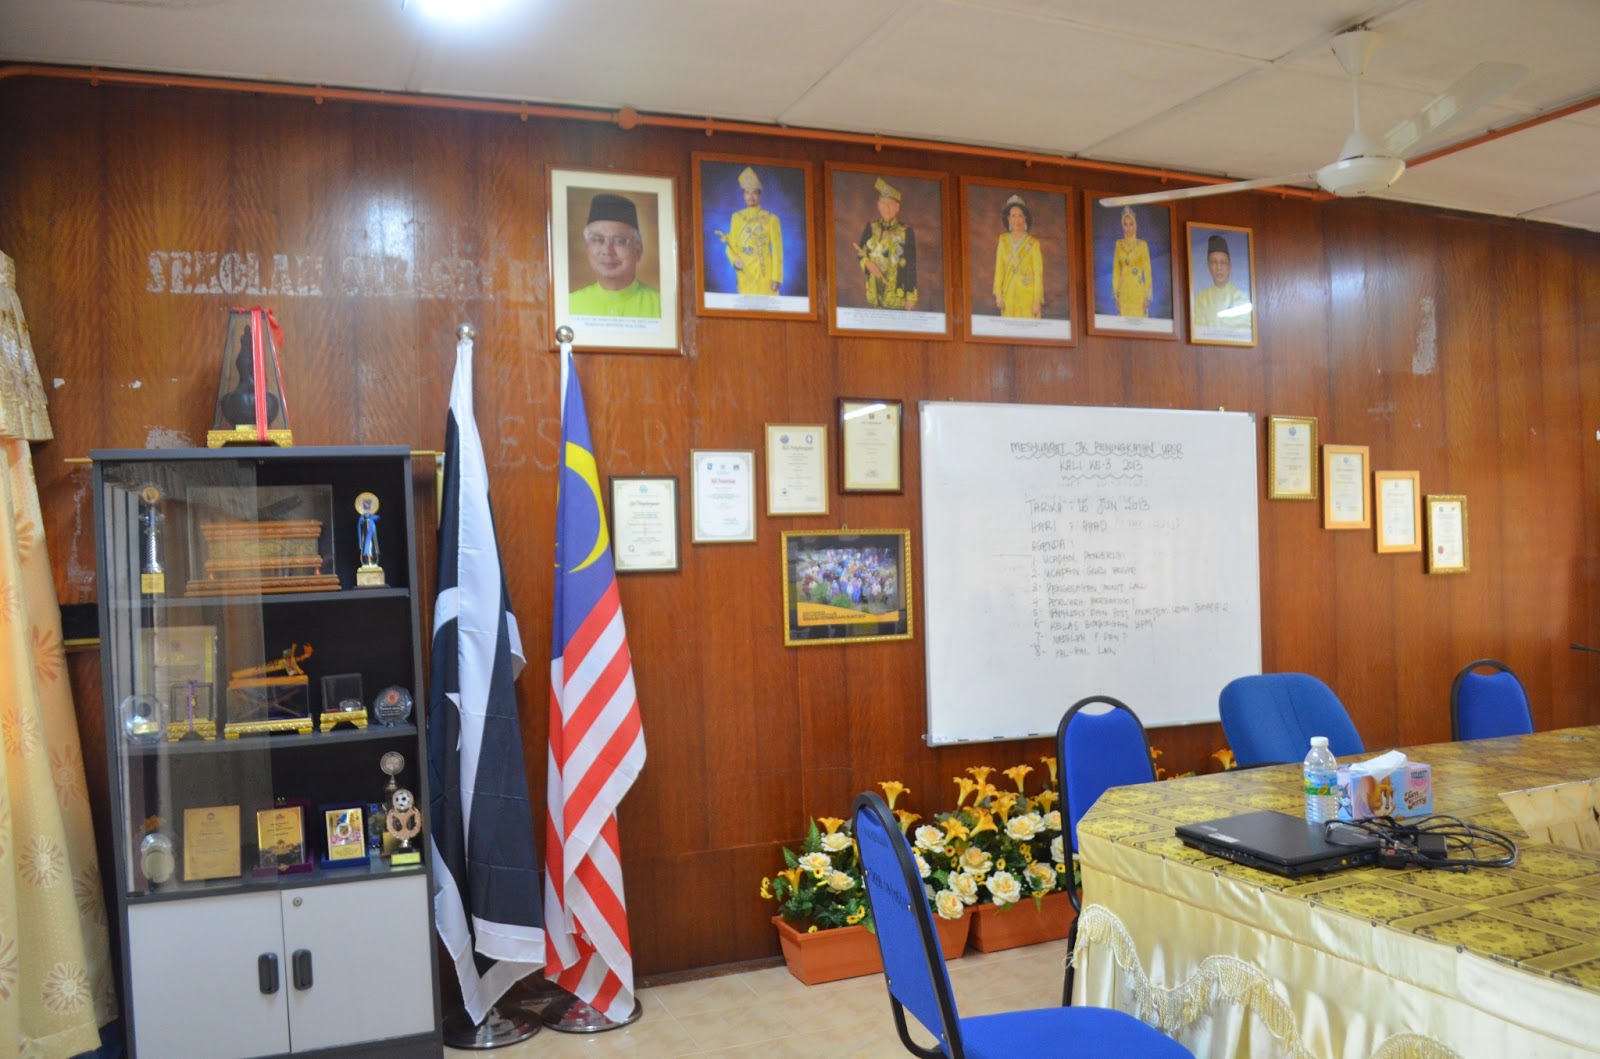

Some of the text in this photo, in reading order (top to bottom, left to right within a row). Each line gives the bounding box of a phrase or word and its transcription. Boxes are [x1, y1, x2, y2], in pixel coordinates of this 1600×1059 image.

[1059, 459, 1082, 471] KALI
[1122, 458, 1144, 471] 2013
[1096, 498, 1118, 514] JUN
[1124, 499, 1151, 511] 2013
